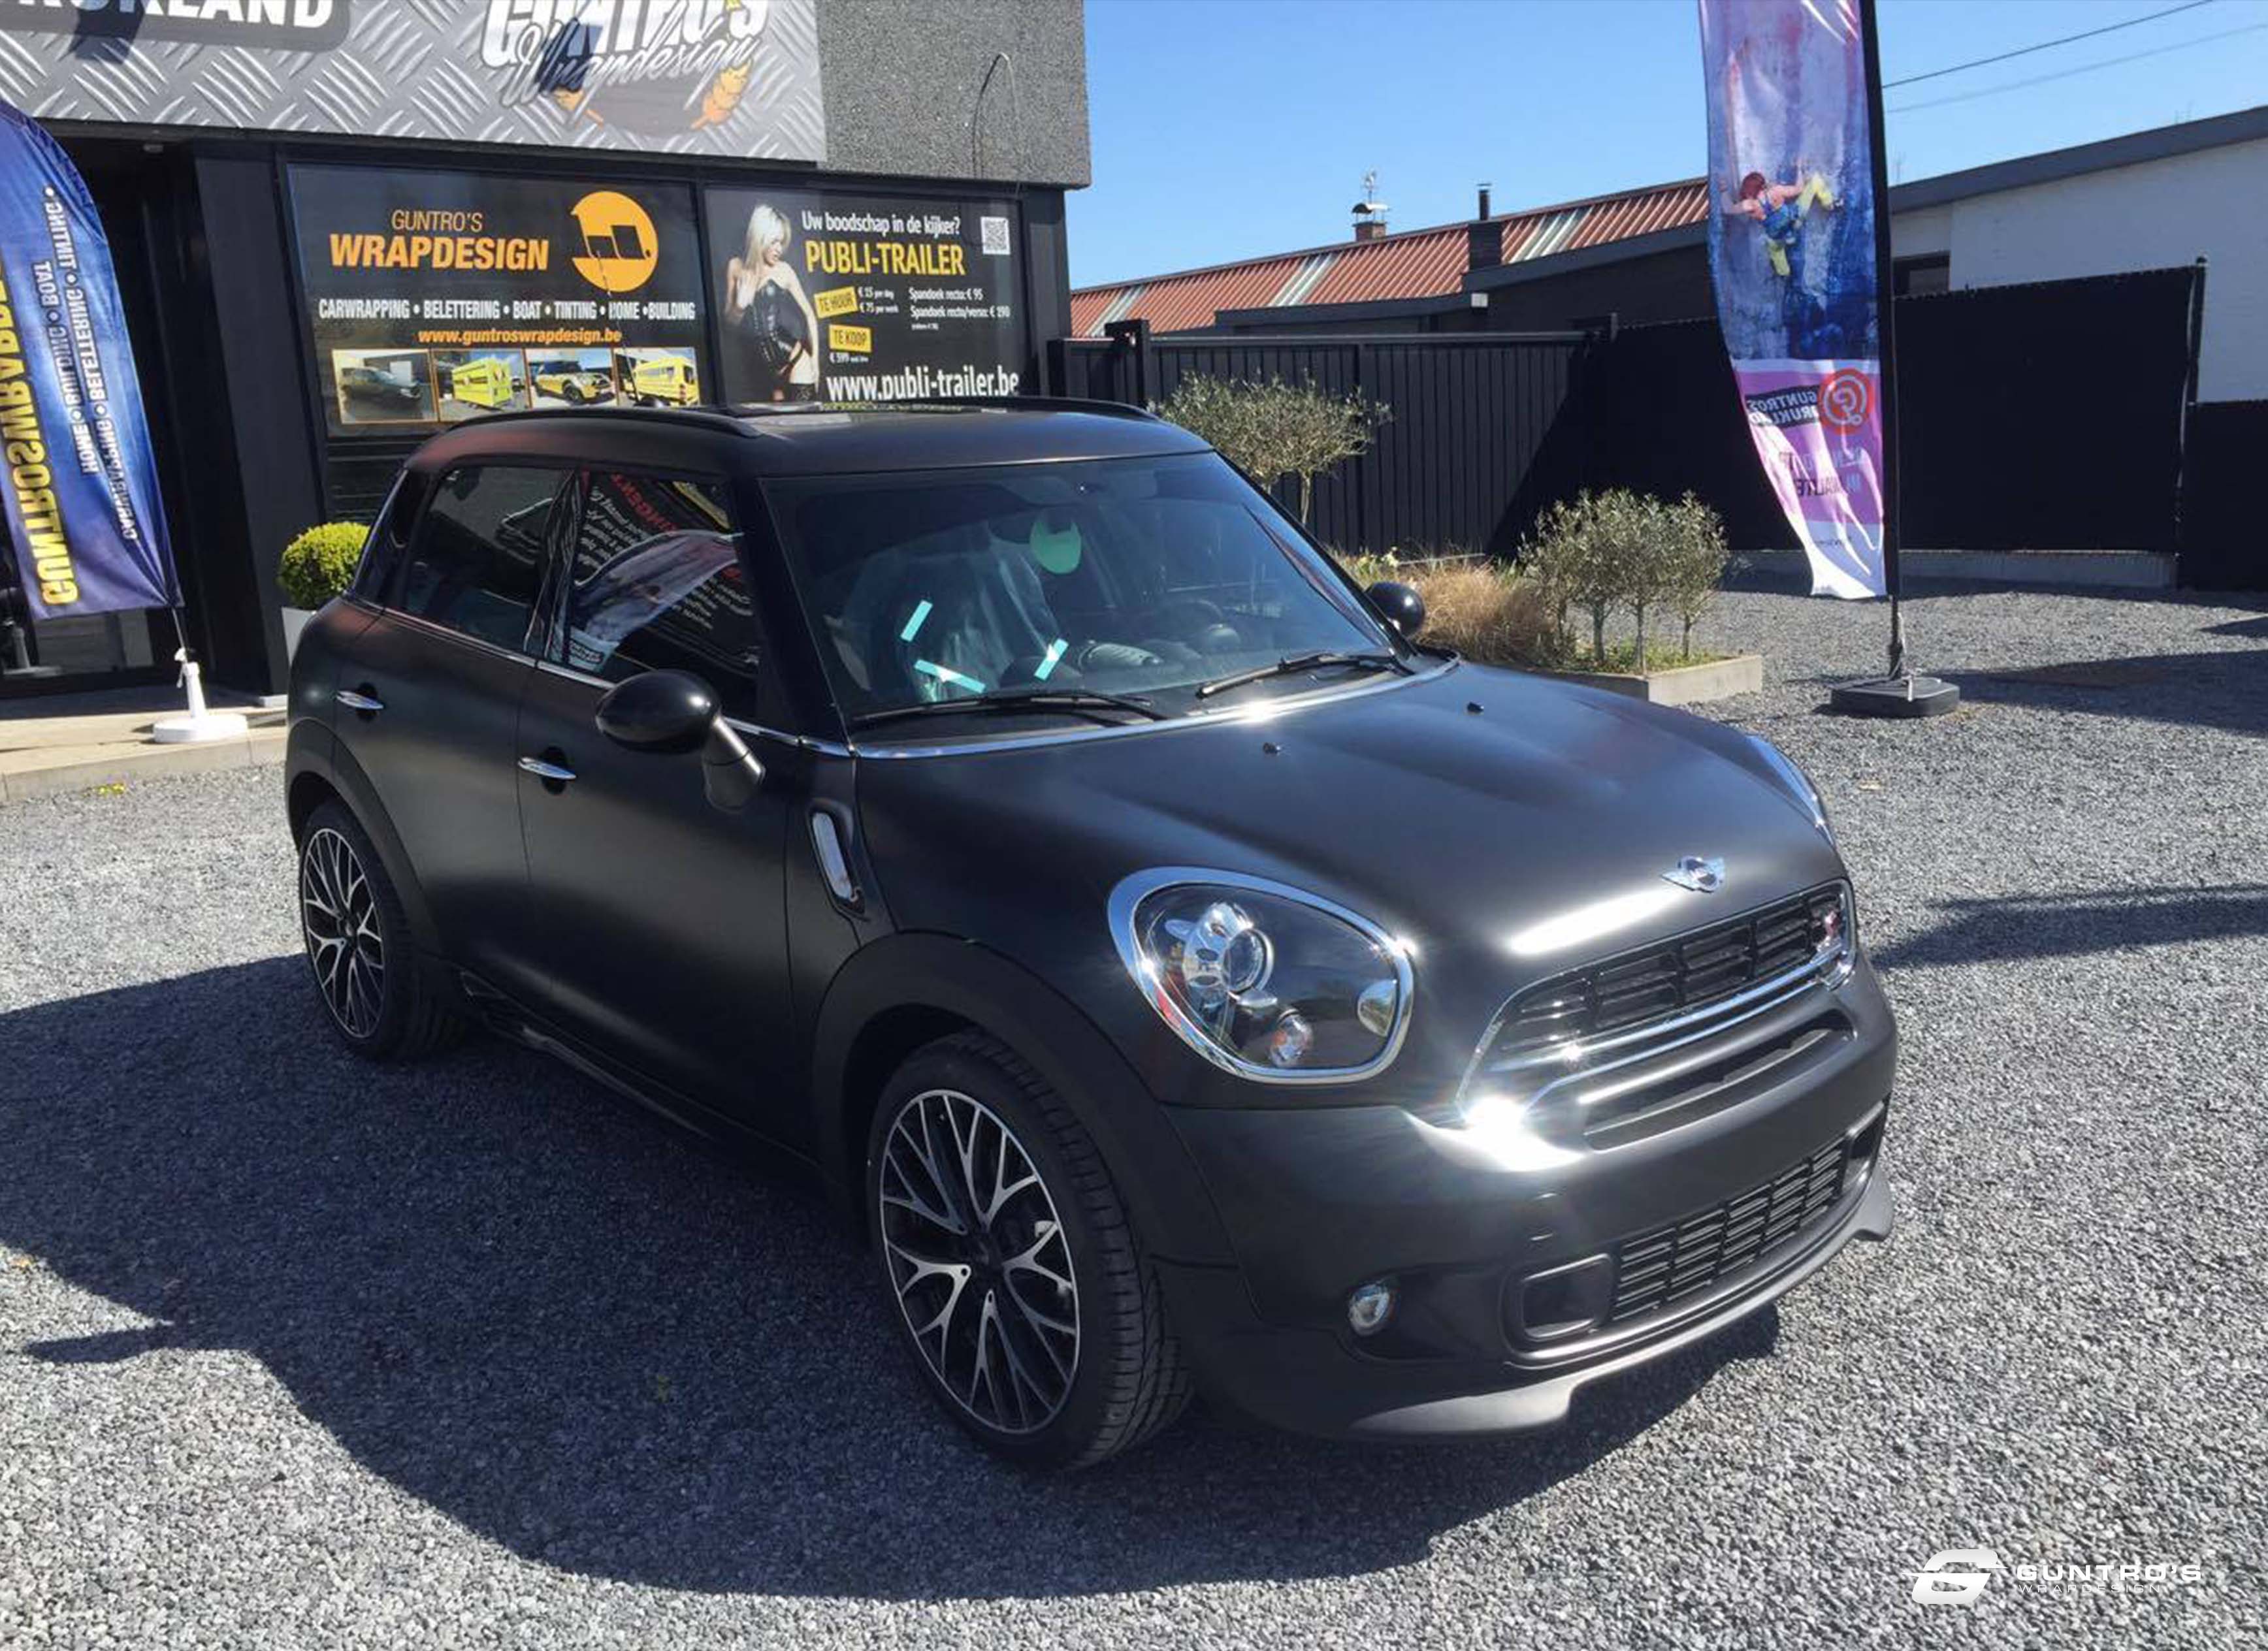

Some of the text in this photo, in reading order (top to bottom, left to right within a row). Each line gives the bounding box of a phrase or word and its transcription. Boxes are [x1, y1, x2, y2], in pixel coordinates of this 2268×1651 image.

[391, 209, 483, 232] GUNTRO'S
[802, 210, 961, 238] Uw boodschap in de kijker?
[330, 233, 549, 270] WRAPDESIGN
[805, 240, 966, 276] PUBLI-TRAILER
[318, 298, 695, 320] CARWRAPPING BELETTERING BOAT TINTING HOME BUILDING
[418, 328, 621, 345] www.guntroswrapdesign.be
[826, 365, 1019, 401] www.publi-trailer.be
